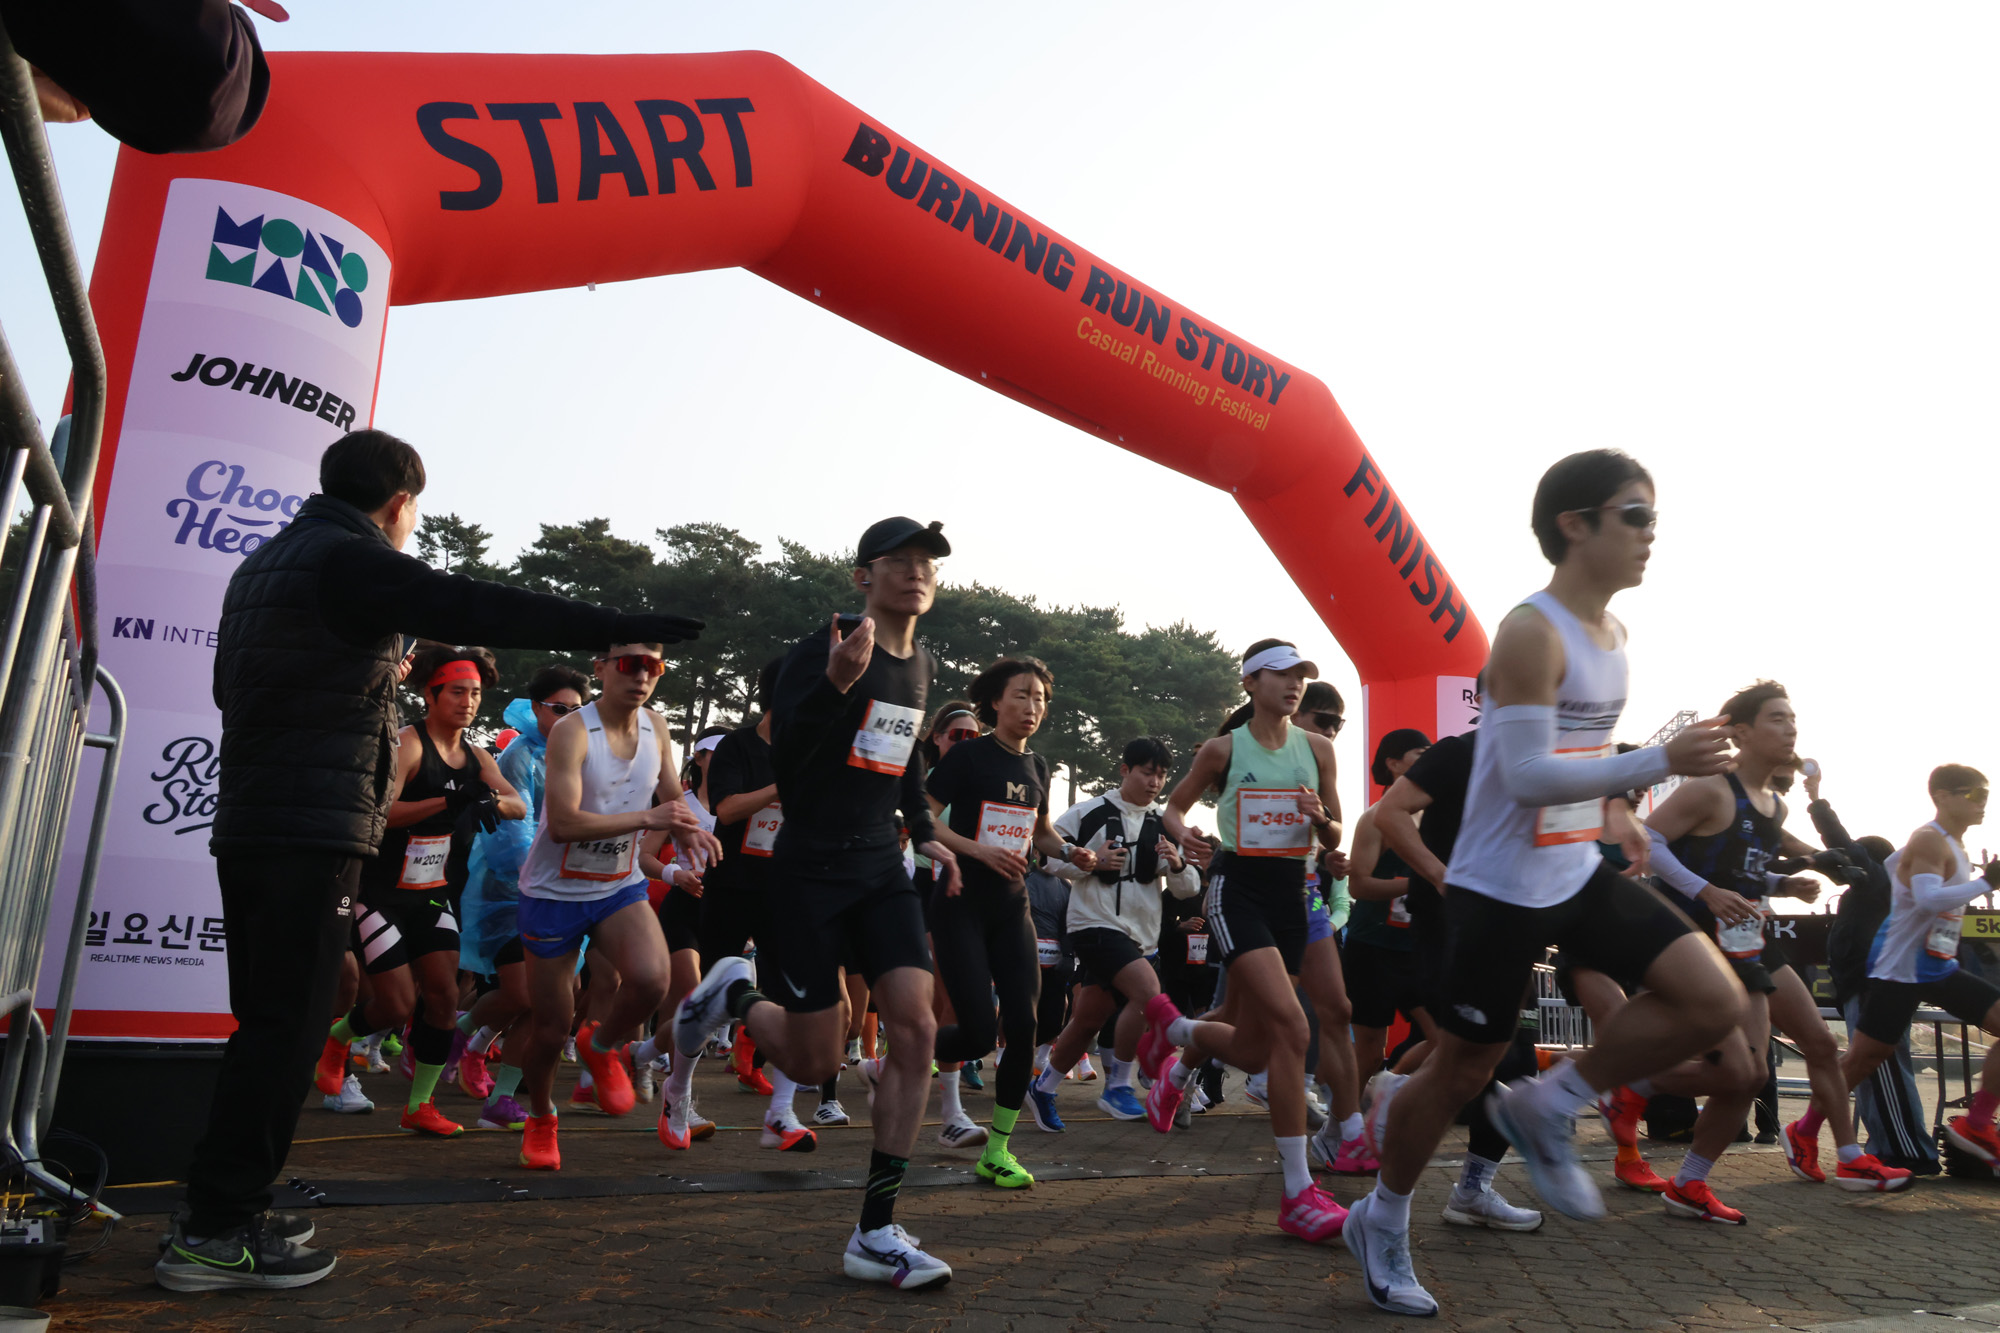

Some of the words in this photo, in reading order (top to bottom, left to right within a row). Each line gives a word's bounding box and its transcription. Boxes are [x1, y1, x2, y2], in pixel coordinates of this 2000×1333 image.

[416, 97, 756, 211] START
[841, 121, 1077, 293] BURNING
[1080, 263, 1171, 346] RUN
[1175, 317, 1291, 406] STORY
[170, 353, 356, 433] JOHNBER
[1076, 316, 1140, 365] Casual
[1139, 349, 1210, 406] Running
[1210, 386, 1271, 431] Festival
[1342, 452, 1467, 644] FINISH
[112, 616, 155, 640] KN
[163, 625, 219, 648] INTE
[85, 911, 226, 952] 일요신문
[90, 953, 141, 964] REALTIME
[143, 955, 172, 965] NEWS
[174, 957, 205, 967] MEDIA
